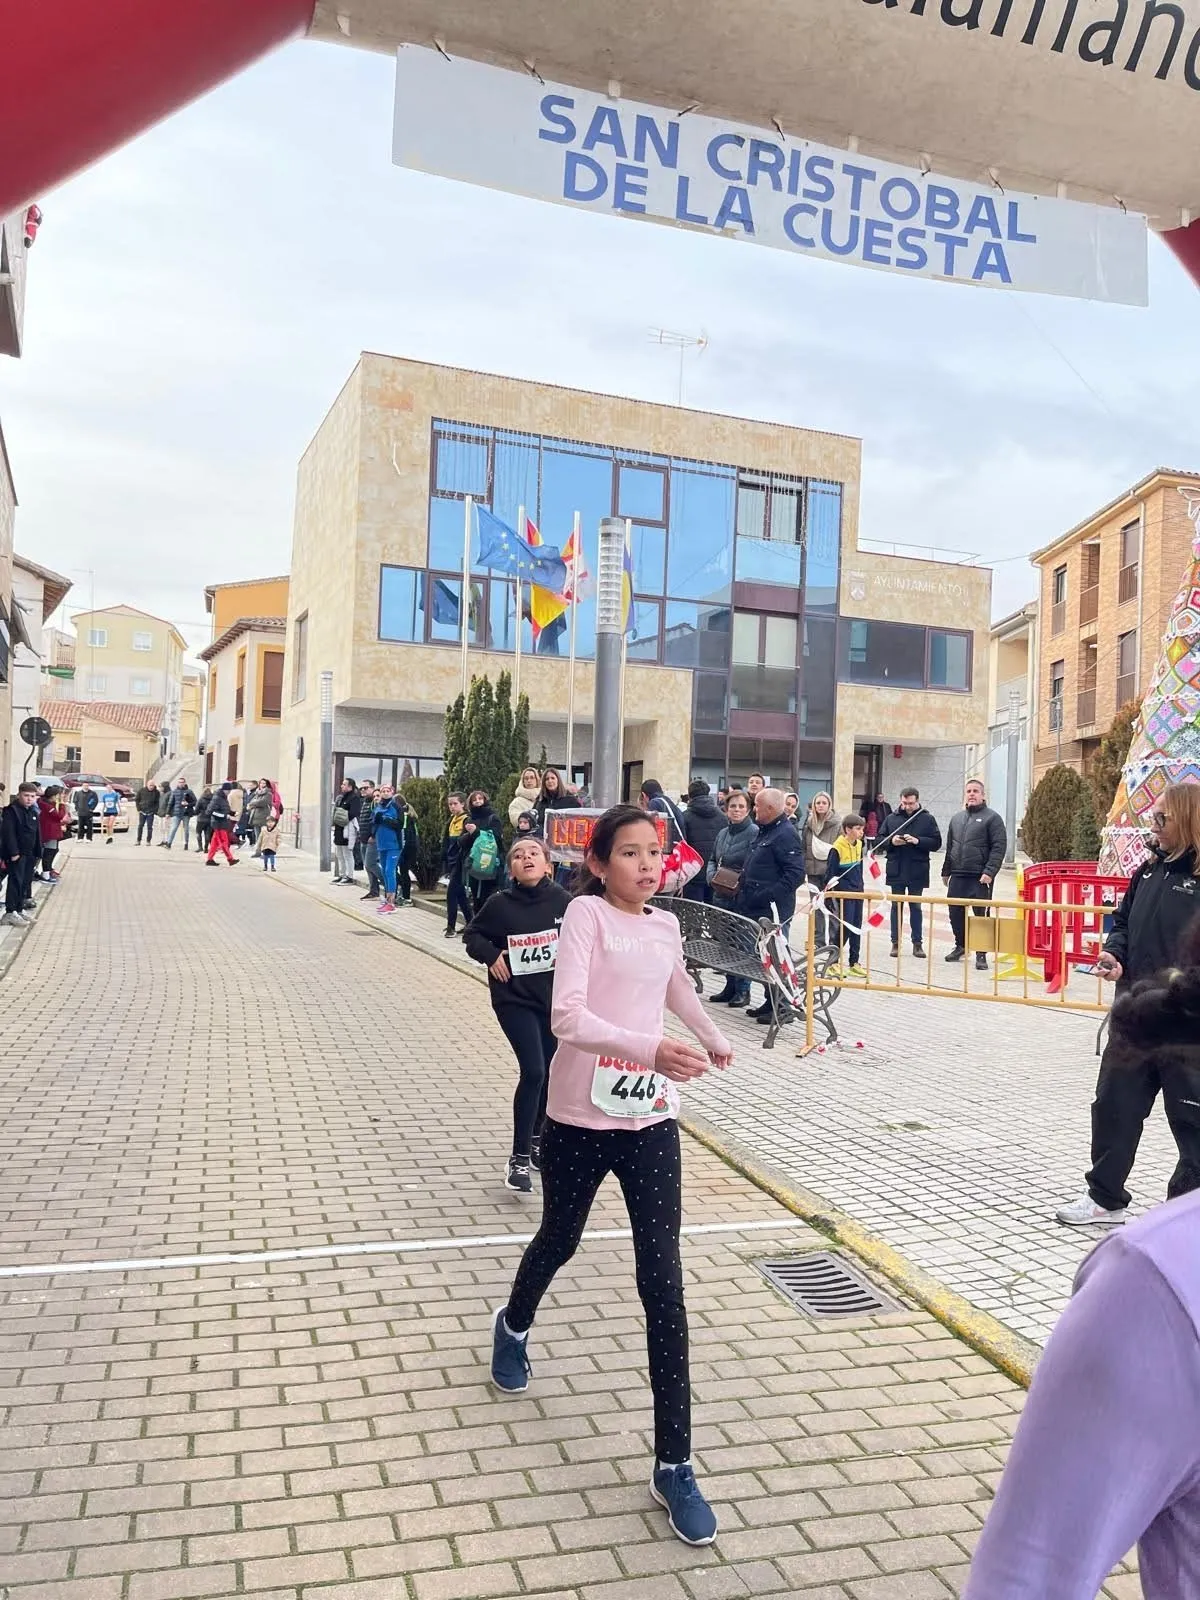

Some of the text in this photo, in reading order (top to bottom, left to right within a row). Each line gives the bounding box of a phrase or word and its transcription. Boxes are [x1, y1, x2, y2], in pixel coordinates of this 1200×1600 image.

[538, 94, 1037, 244] SAN CRISTOBAL
[563, 150, 1012, 283] DE LA CUESTA
[873, 575, 962, 597] AYUNTAMIENTO
[520, 945, 552, 964] 445
[611, 1073, 656, 1100] 446
